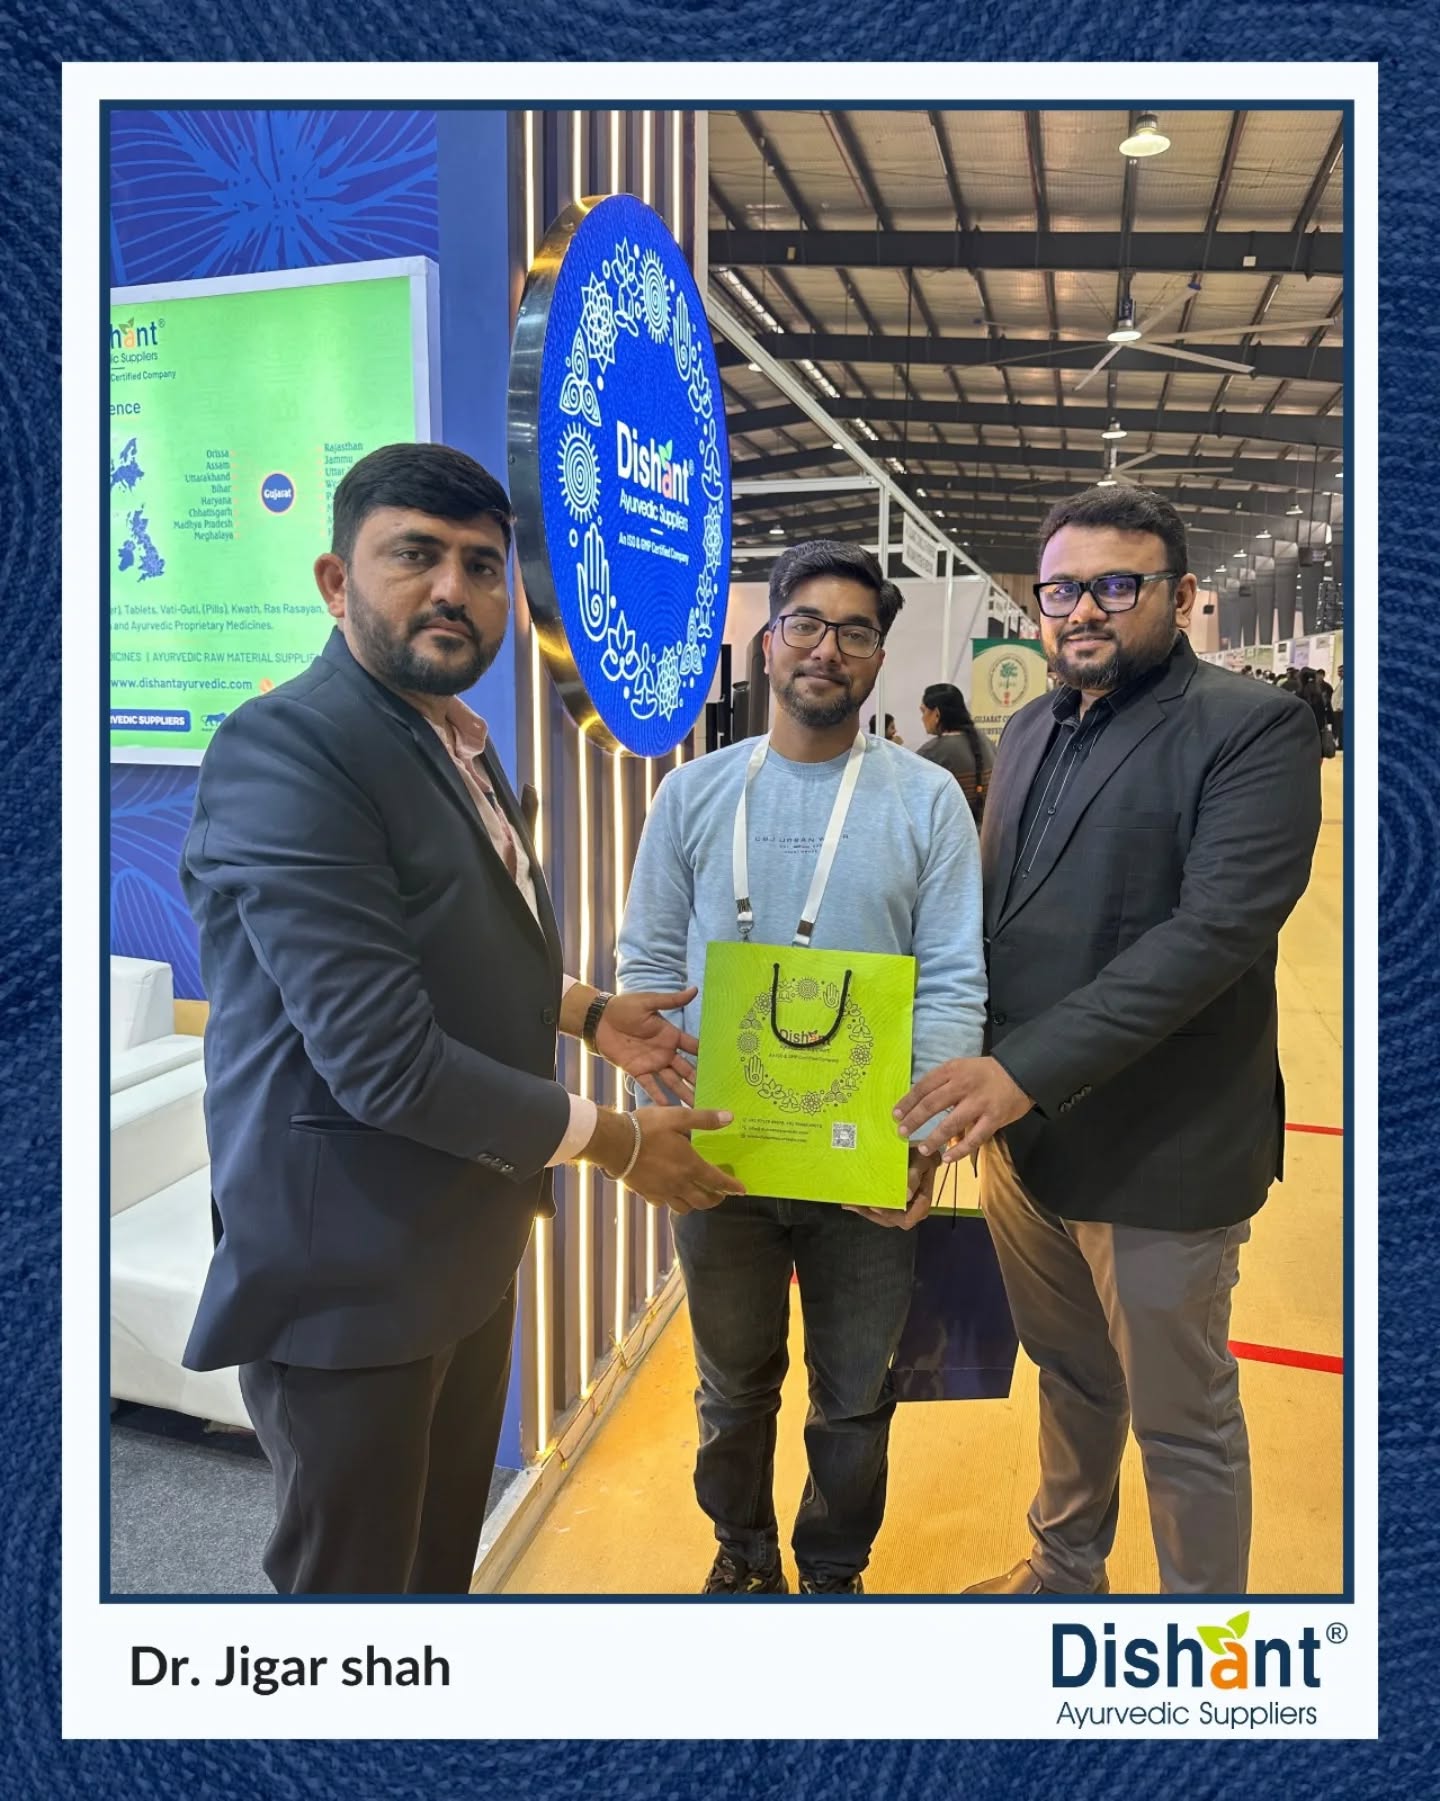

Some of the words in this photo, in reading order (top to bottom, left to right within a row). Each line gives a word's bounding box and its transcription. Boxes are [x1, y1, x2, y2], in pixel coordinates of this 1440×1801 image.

[121, 352, 158, 363] Suppliers
[143, 371, 177, 380] Company
[324, 442, 363, 453] Rajasthan
[207, 450, 229, 458] Orissa
[325, 456, 353, 464] Jammu
[207, 462, 230, 470] Assam
[185, 472, 230, 483] Uttarakhand
[212, 485, 231, 493] Bihar
[264, 488, 291, 500] Gujarat
[201, 497, 232, 506] Haryana
[619, 488, 659, 520] Ayurvedic
[660, 503, 689, 532] Suppliers
[174, 520, 202, 530] Madhya
[204, 520, 233, 528] Pradesh
[194, 531, 233, 541] Meghalaya
[264, 604, 280, 613] Ras
[114, 621, 129, 630] and
[131, 621, 173, 632] Ayurvedic
[175, 620, 224, 633] Proprietary
[153, 652, 203, 663] AYURVEDIC
[205, 652, 225, 662] RAW
[227, 652, 273, 663] MATERIAL
[111, 678, 253, 691] www.dishantayurvedic.com
[139, 715, 186, 726] SUPPLIERS
